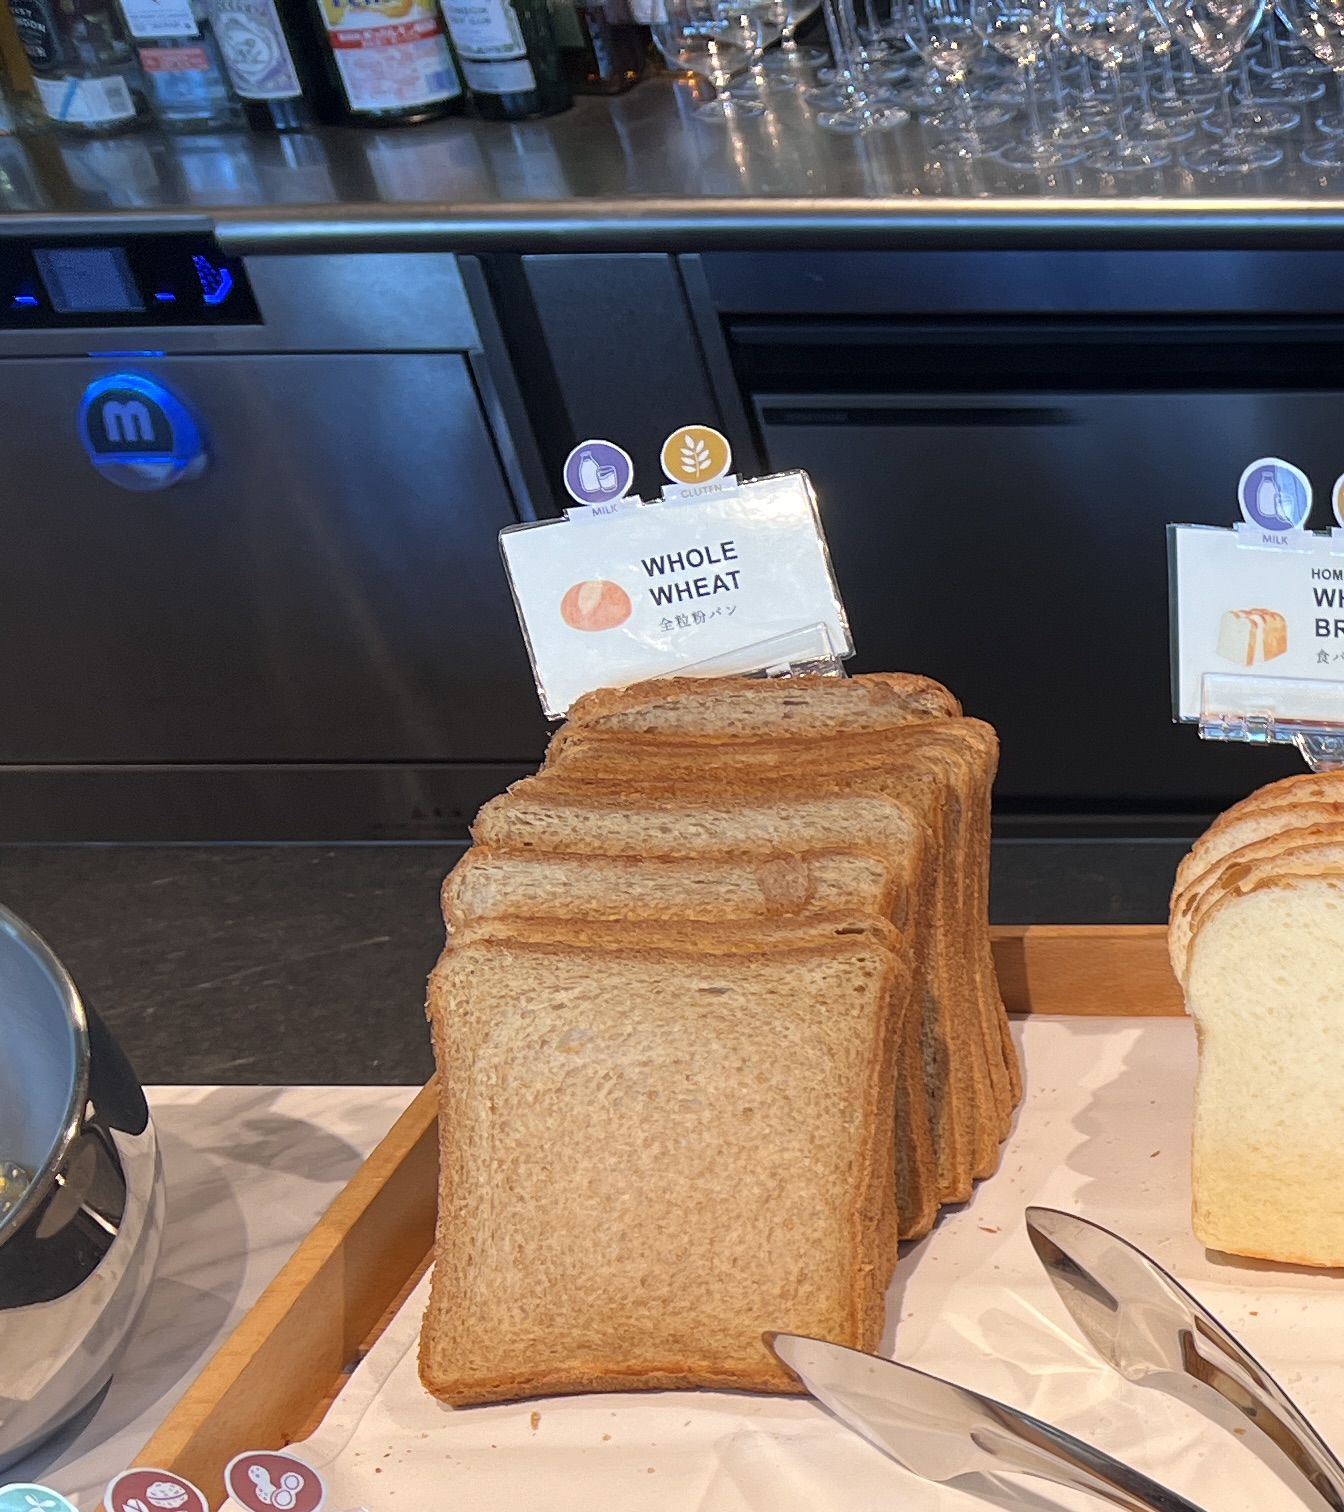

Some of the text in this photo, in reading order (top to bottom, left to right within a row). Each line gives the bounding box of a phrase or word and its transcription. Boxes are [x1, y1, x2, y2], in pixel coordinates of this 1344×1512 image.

[680, 483, 723, 499] GLUTEN
[592, 504, 618, 517] MILK
[1262, 534, 1288, 546] MILK
[641, 540, 739, 577] WHOLE
[648, 570, 741, 607] WHEAT
[659, 605, 737, 633] 全粒粉パン
